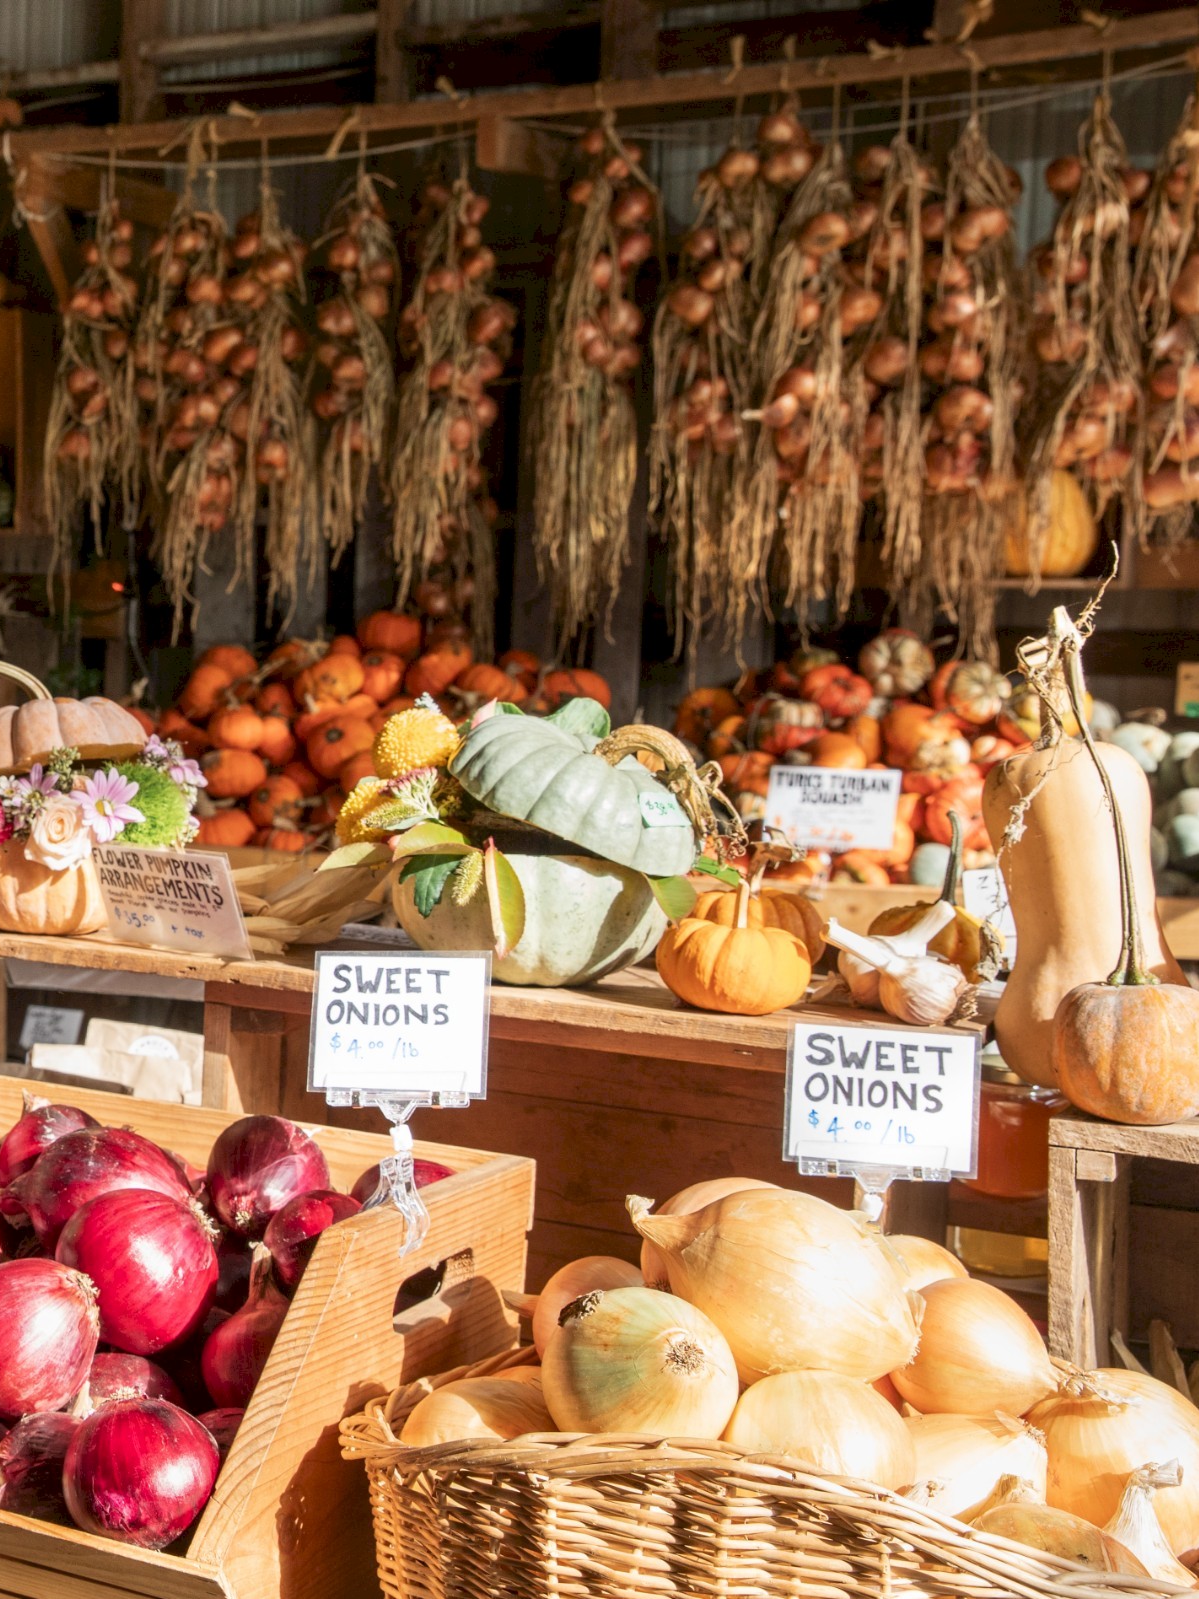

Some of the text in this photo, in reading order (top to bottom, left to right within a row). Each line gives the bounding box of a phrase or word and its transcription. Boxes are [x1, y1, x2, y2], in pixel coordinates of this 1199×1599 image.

[91, 847, 214, 881] FLOWER PUMPKIN
[100, 867, 224, 906] ARRANGEMENTS
[332, 963, 450, 995] SWEET
[325, 999, 450, 1027] ONIONS
[805, 1032, 953, 1076] SWEET
[804, 1071, 944, 1113] ONIONS
